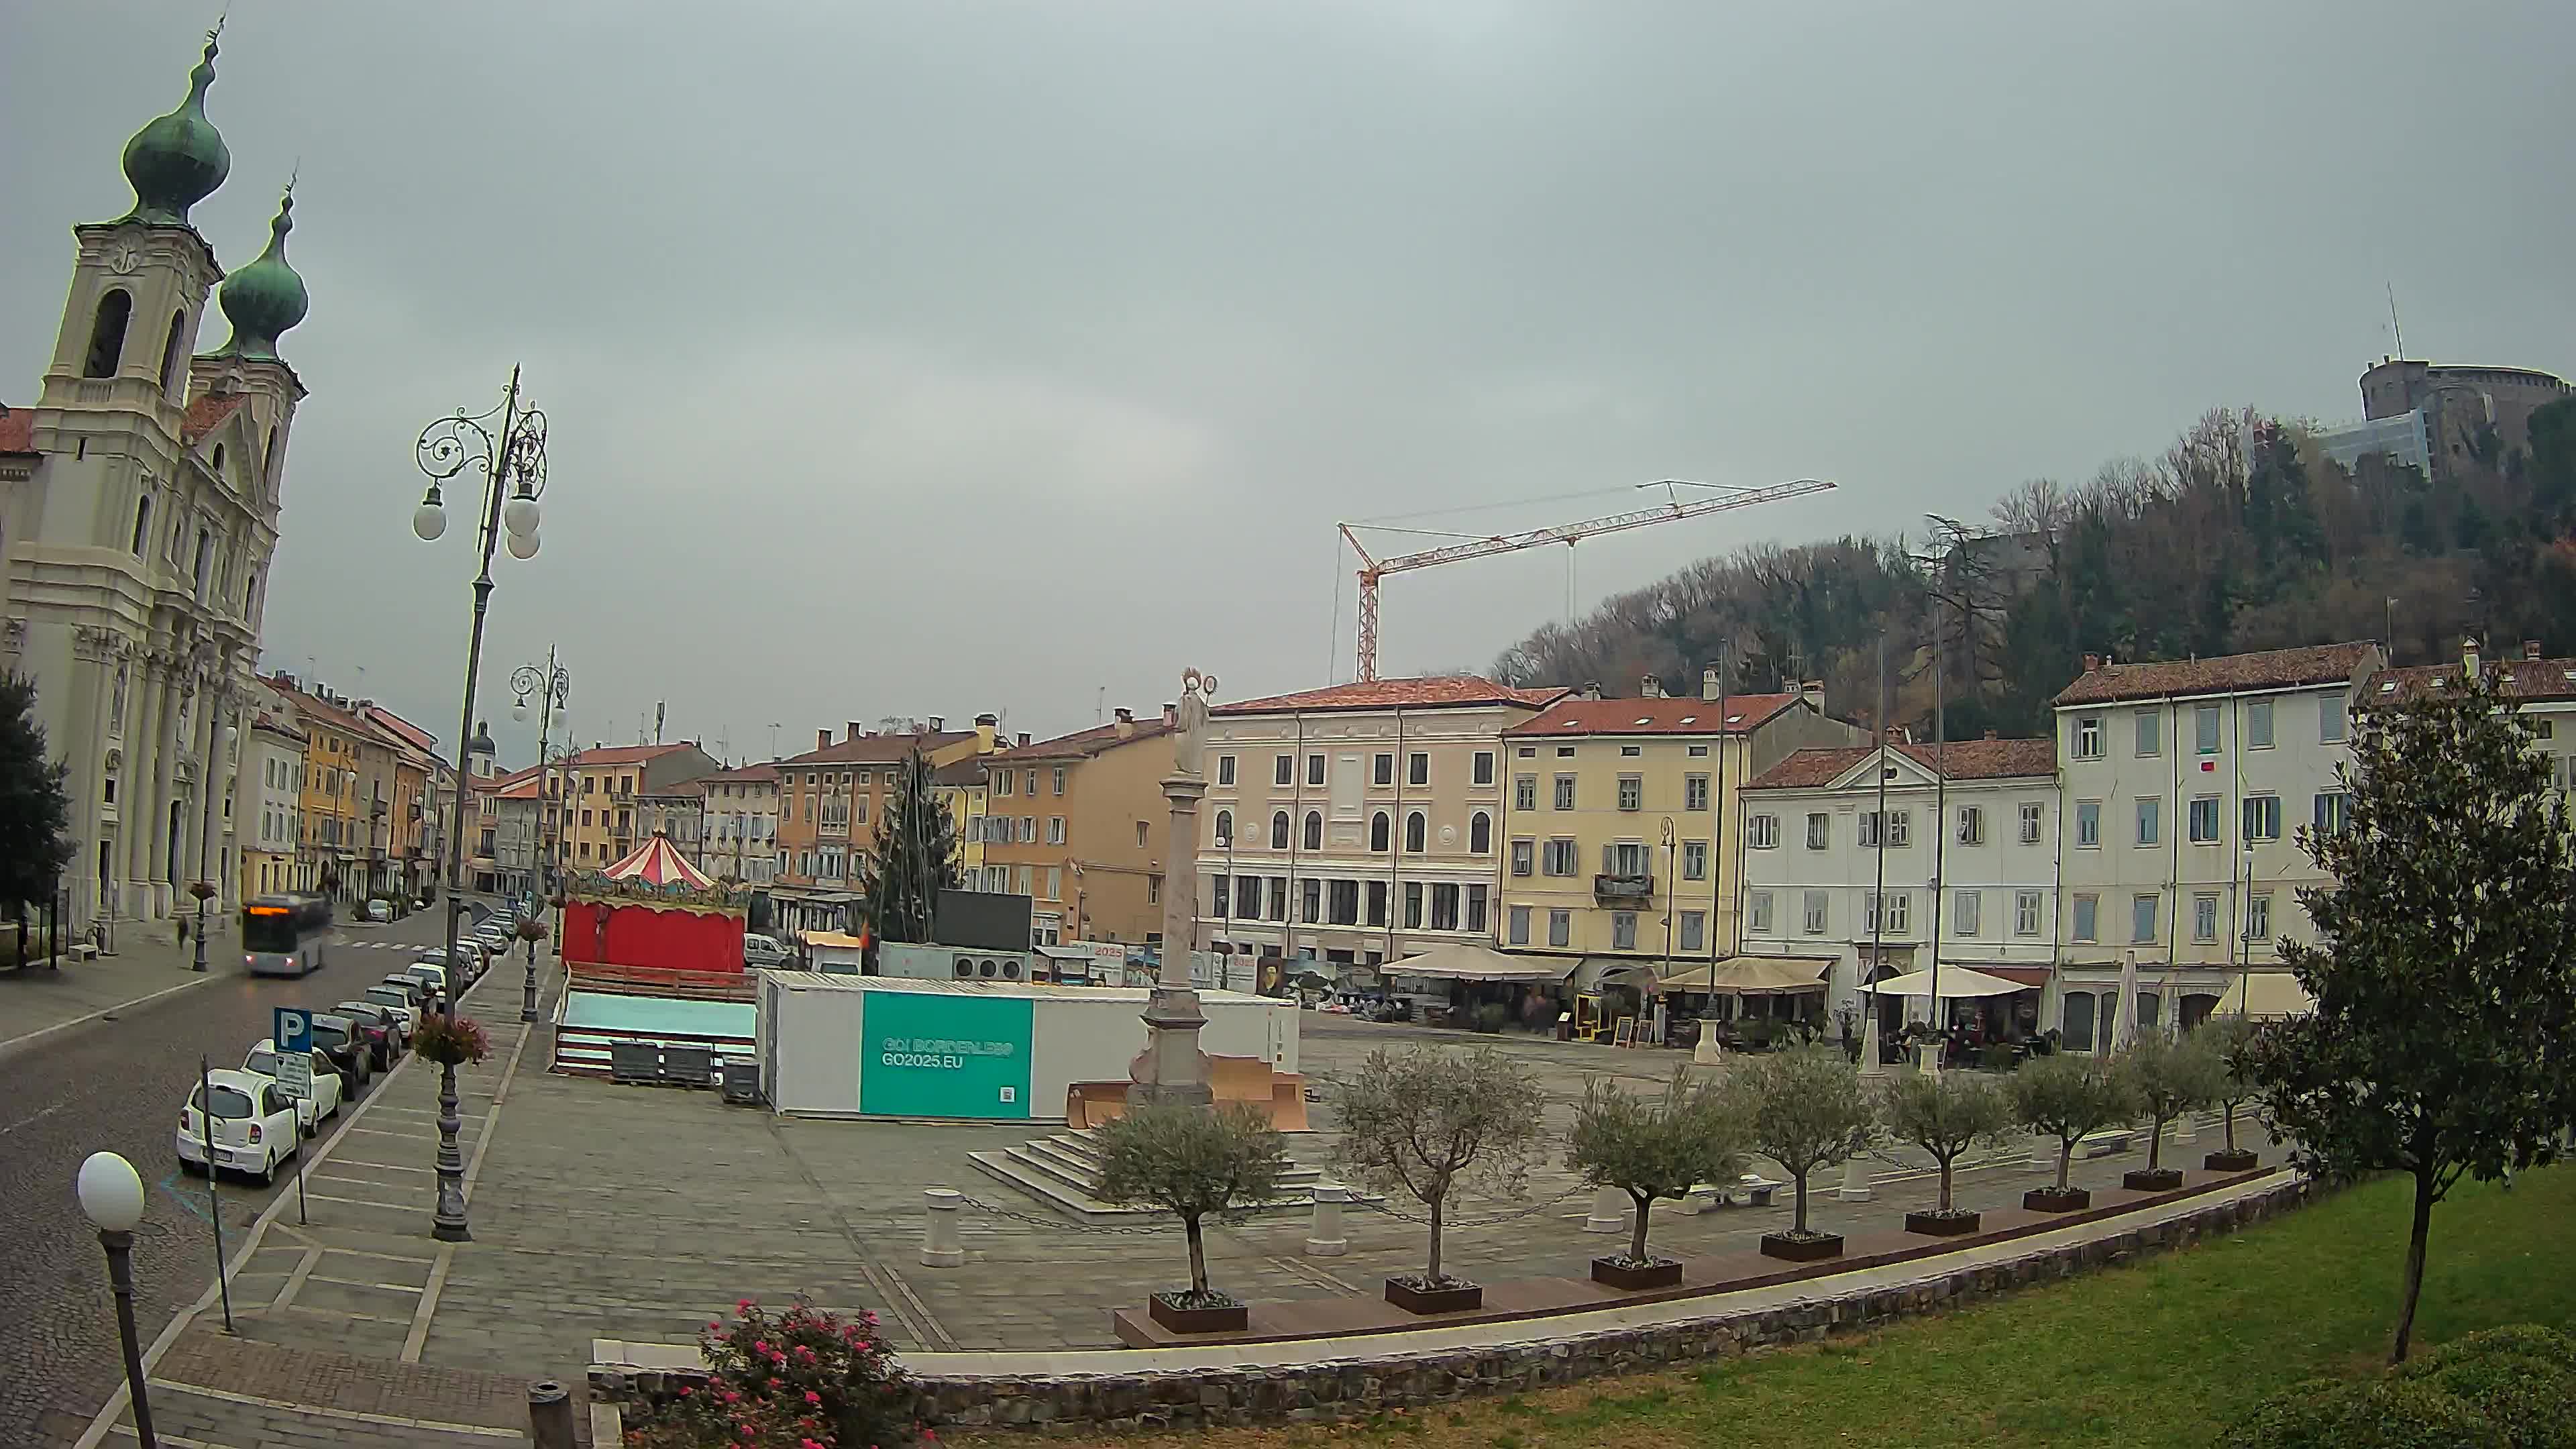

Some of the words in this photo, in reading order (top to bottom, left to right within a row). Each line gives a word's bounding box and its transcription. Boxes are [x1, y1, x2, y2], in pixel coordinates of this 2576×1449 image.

[1094, 947, 1122, 957] 2025
[281, 1012, 305, 1047] P
[882, 1053, 963, 1069] GO2025.EU
